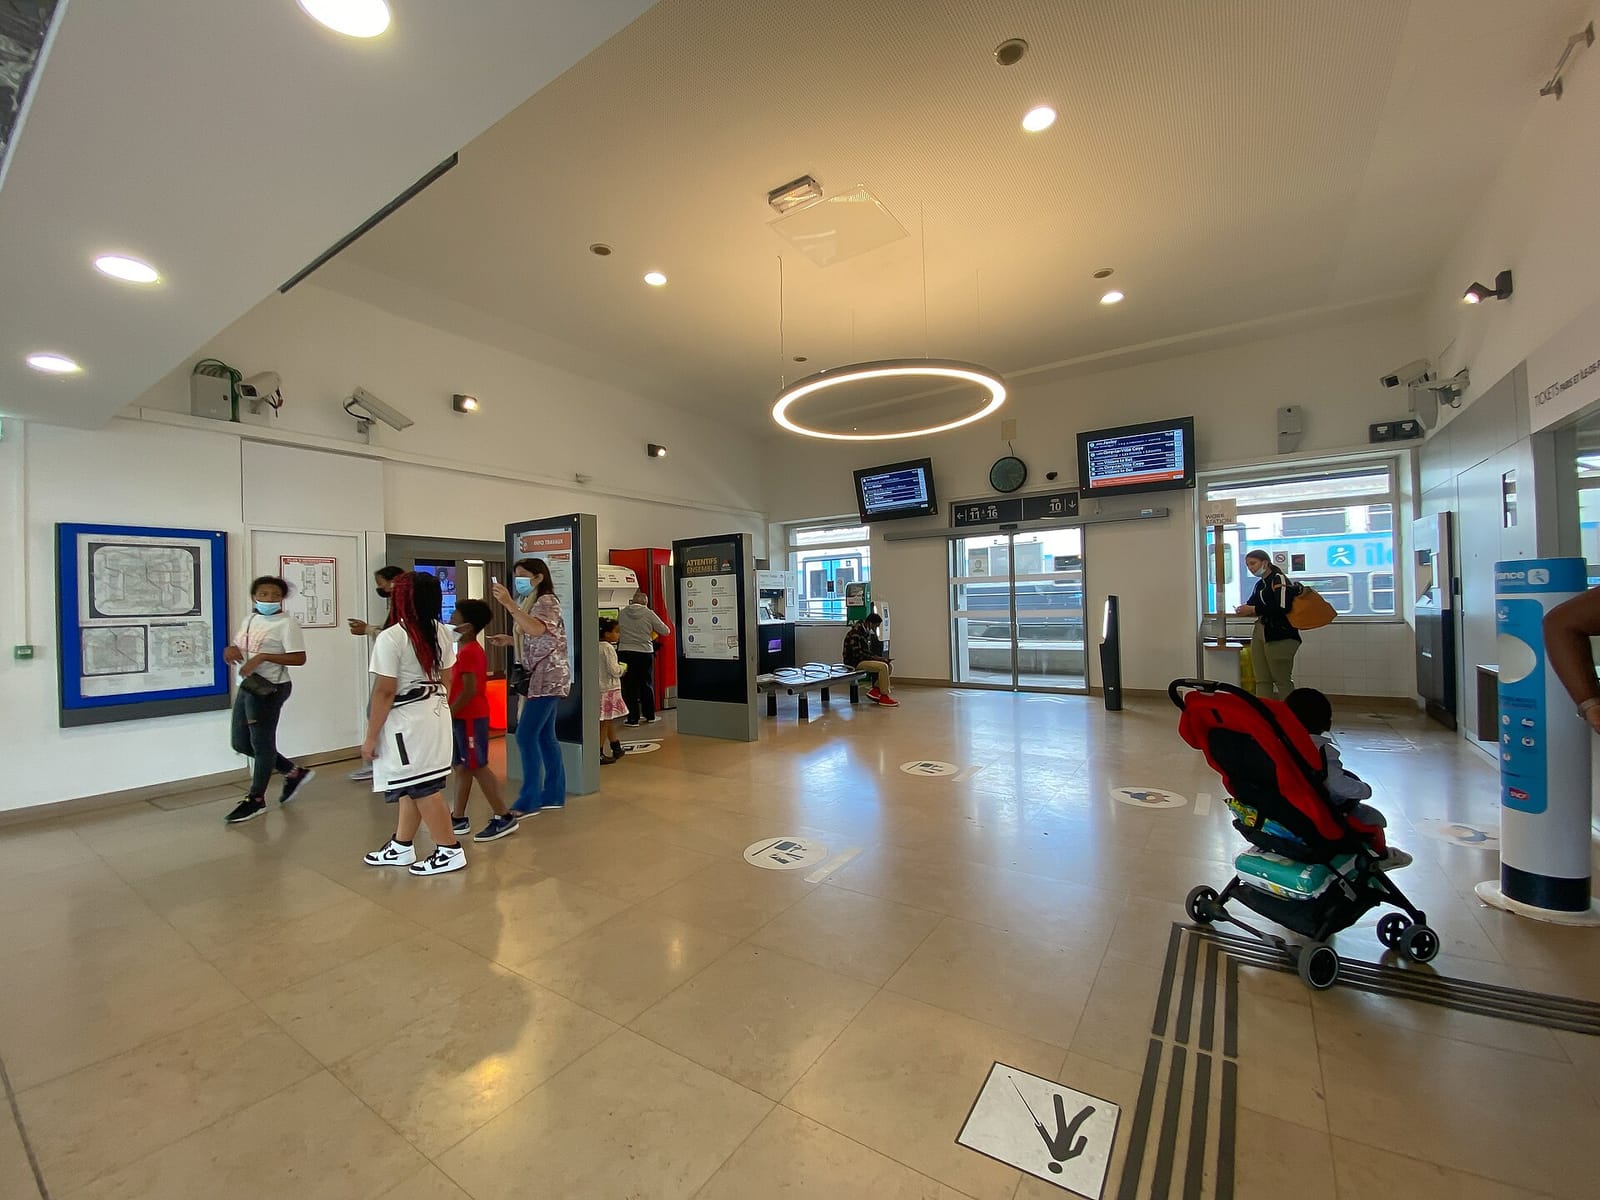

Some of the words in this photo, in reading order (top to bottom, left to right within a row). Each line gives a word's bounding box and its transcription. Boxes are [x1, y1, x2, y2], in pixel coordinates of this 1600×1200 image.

[1050, 502, 1061, 512] 10
[970, 511, 980, 519] 11
[987, 510, 998, 518] 16
[687, 557, 717, 567] ATTENTIFS
[687, 565, 717, 575] ENSEMBLE
